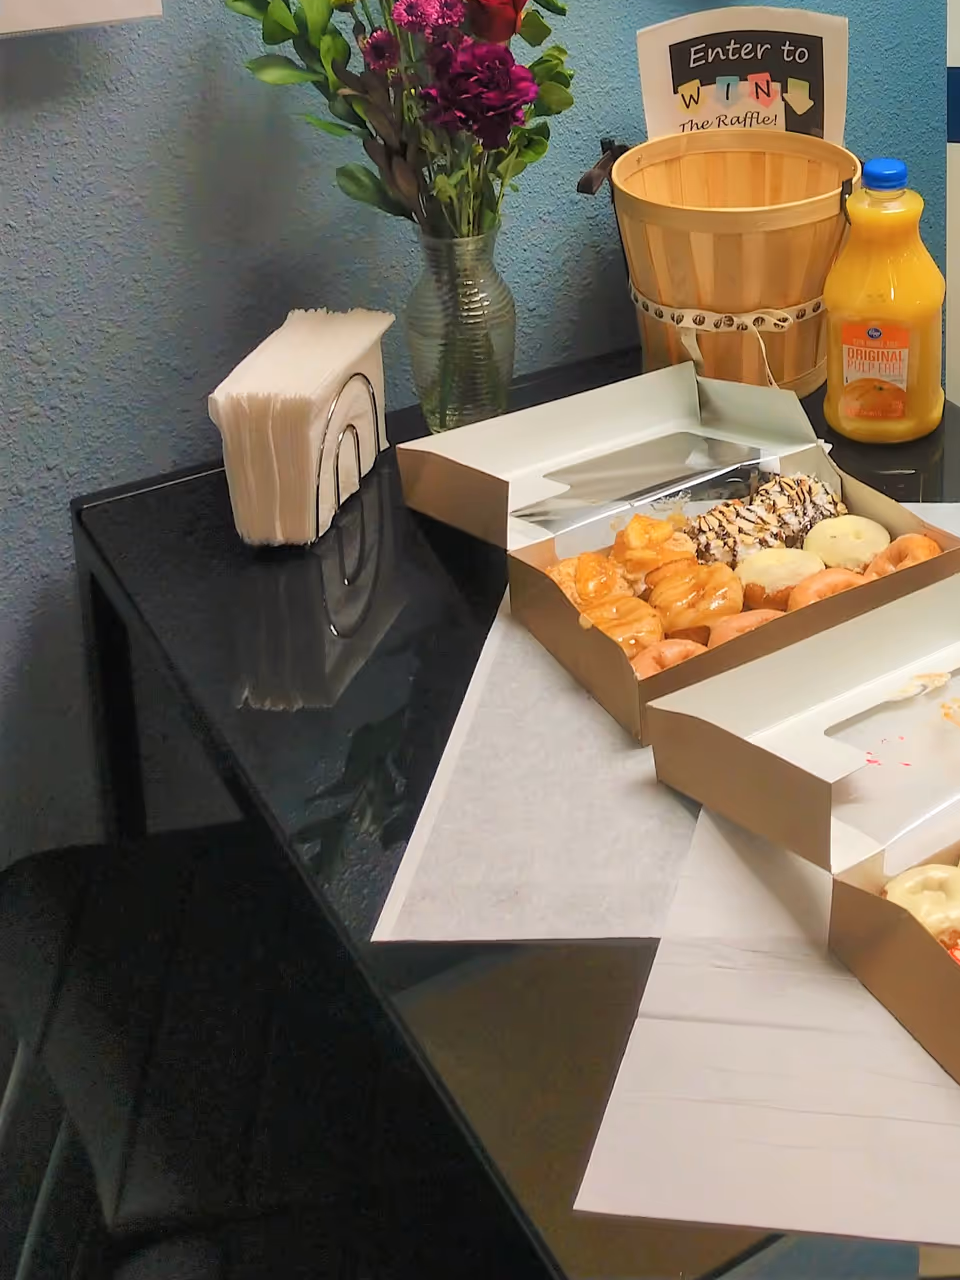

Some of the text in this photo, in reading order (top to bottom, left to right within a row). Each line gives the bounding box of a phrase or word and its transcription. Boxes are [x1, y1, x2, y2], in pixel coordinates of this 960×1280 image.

[690, 39, 809, 68] Enter to
[679, 111, 779, 133] The Raffle!
[847, 347, 903, 363] ORIGINAL
